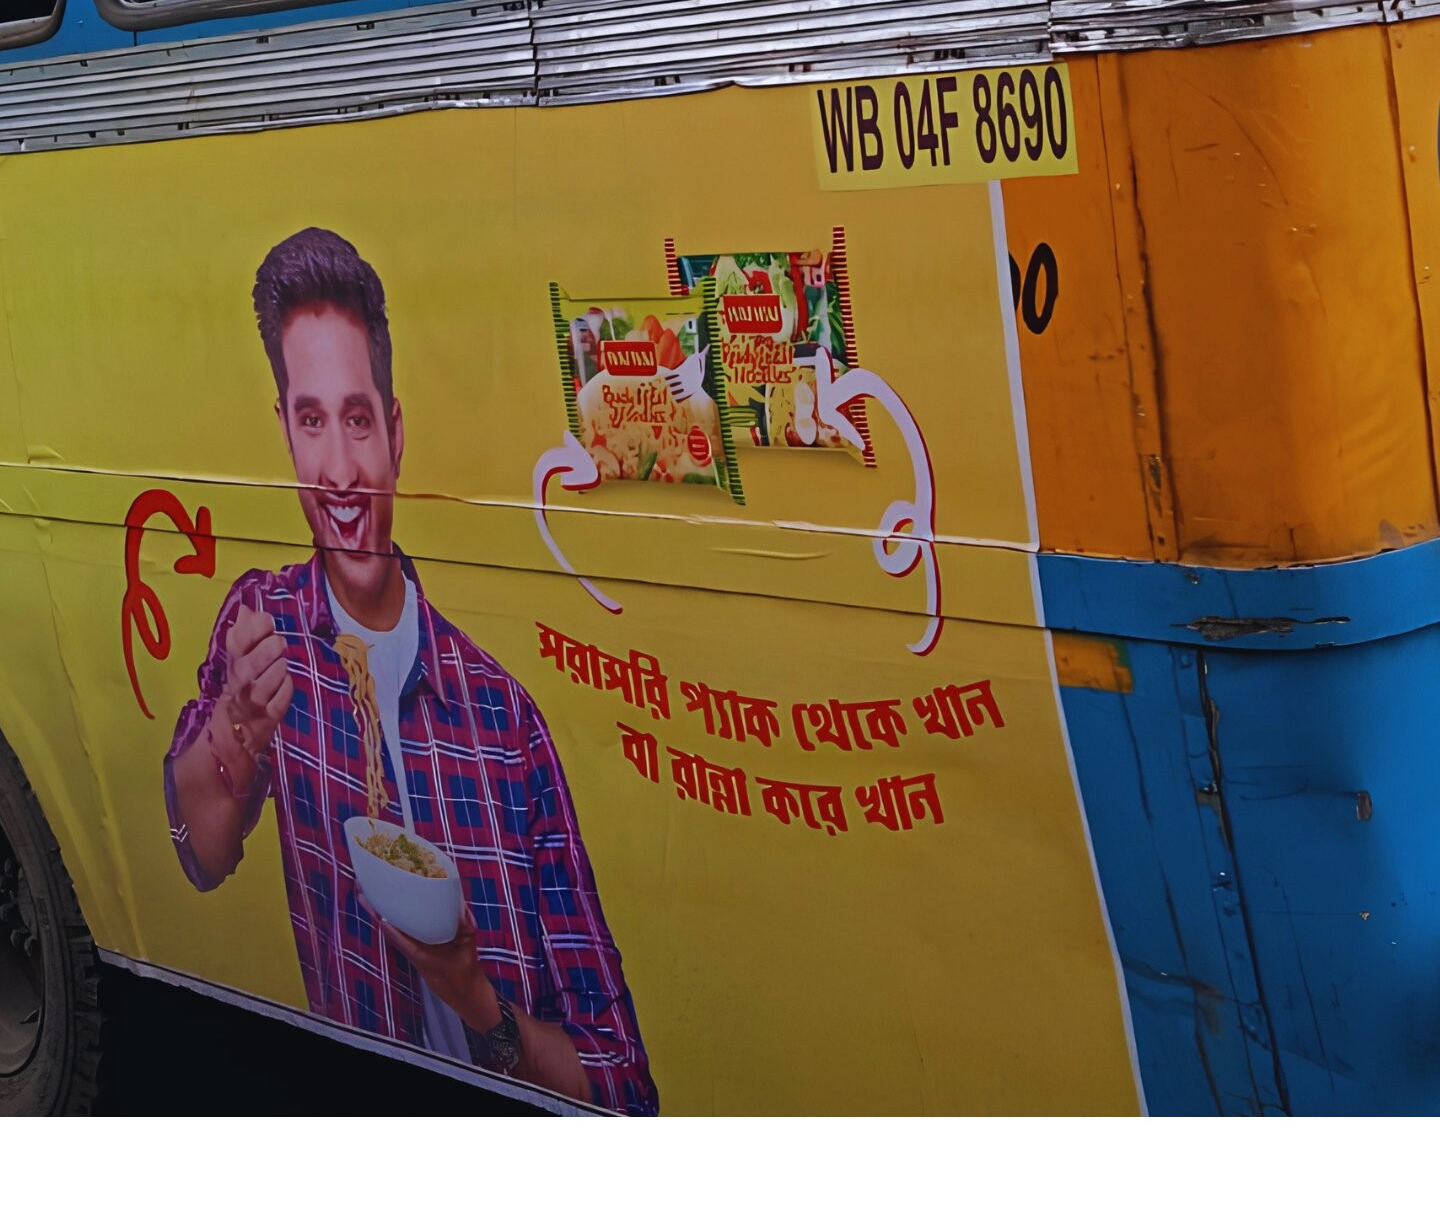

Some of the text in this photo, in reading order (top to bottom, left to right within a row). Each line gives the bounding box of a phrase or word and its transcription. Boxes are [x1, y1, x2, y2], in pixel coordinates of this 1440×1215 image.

[817, 66, 1068, 174] WB 04F 8690
[1008, 241, 1059, 334] 0
[535, 621, 1006, 753] সরাসরি প্যাক থেকে খান
[616, 720, 945, 837] বা রান্না করে খান
